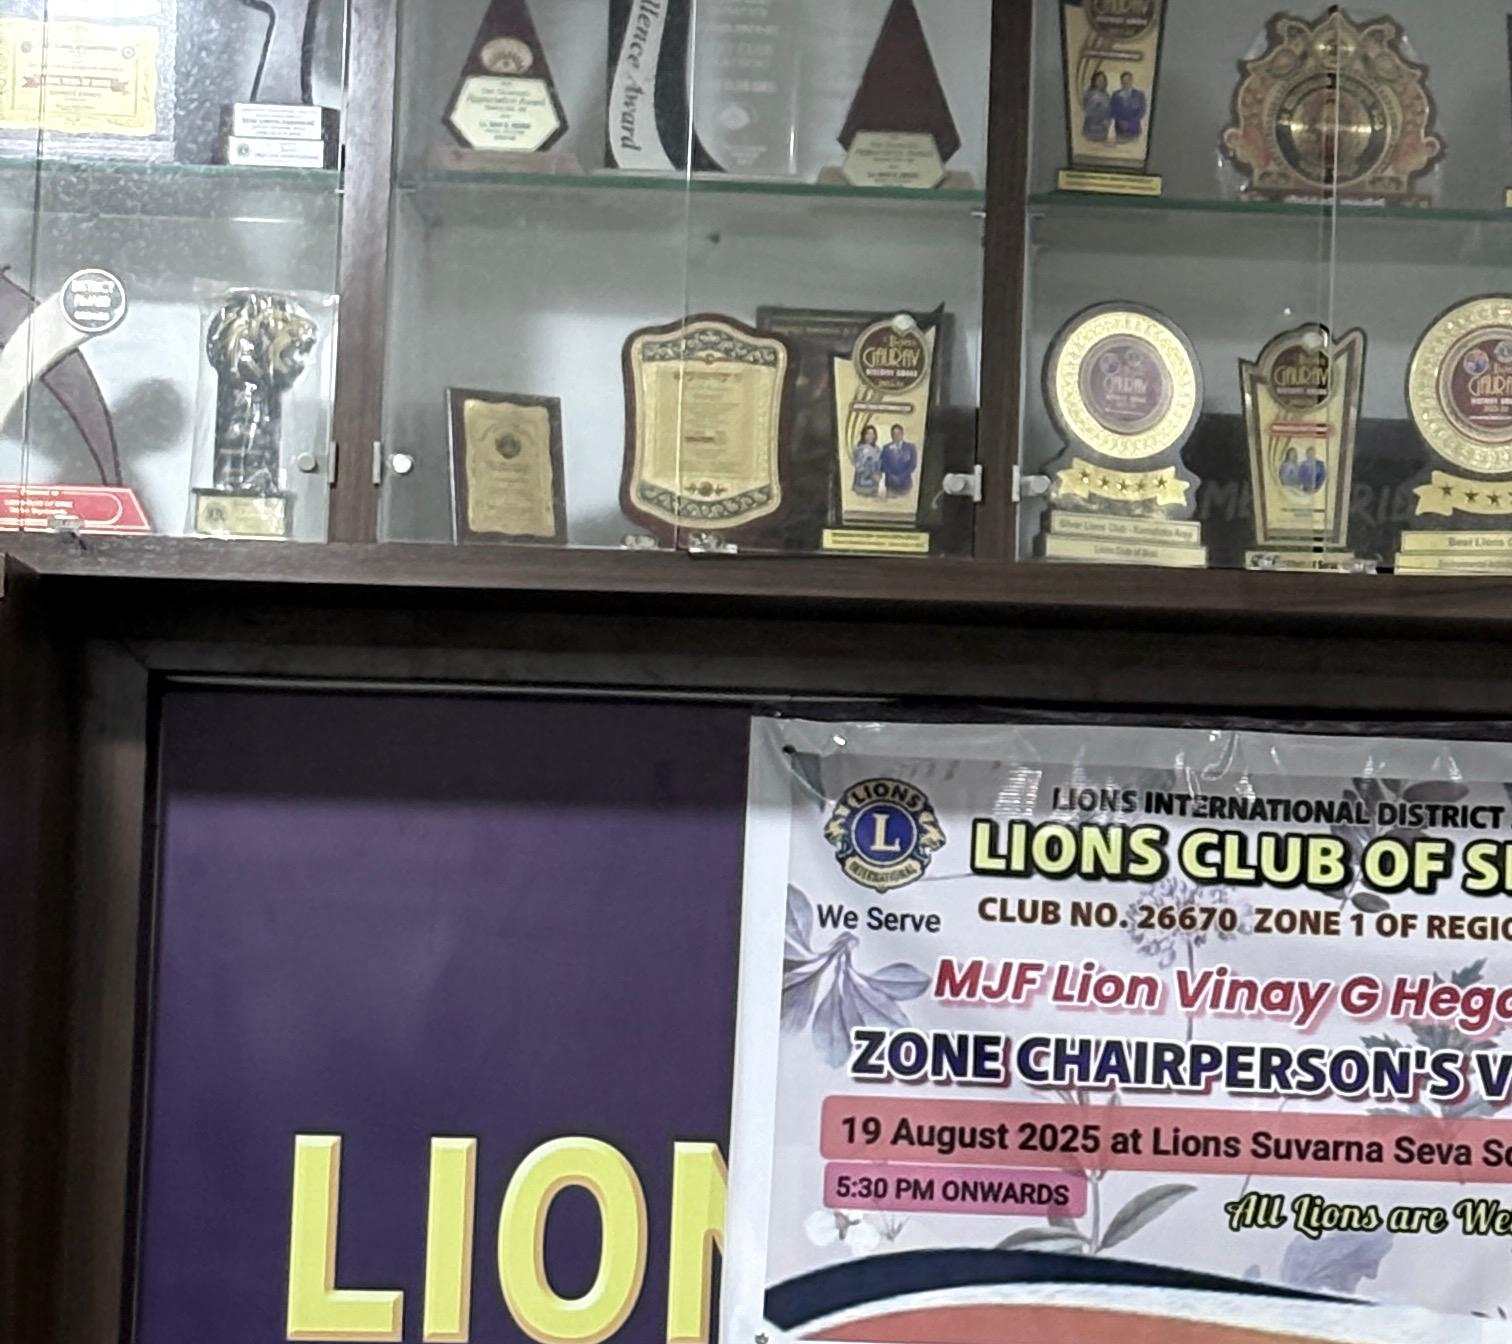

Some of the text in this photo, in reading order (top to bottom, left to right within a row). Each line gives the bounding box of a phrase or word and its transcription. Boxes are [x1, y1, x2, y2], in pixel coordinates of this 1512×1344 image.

[620, 75, 645, 152] Award
[851, 782, 921, 809] LIONS
[1053, 787, 1137, 814] LIONS
[1144, 791, 1370, 826] INTERNATIONAL
[1377, 801, 1506, 831] DISTRICT
[870, 813, 901, 851] L
[973, 819, 1167, 882] LIONS
[1180, 828, 1351, 890] CLUB
[1362, 836, 1454, 894] OF
[817, 903, 942, 934] We Serve
[978, 897, 1061, 925] CLUB
[1070, 901, 1129, 929] NO.
[1137, 904, 1238, 932] 26670
[1253, 907, 1341, 936] ZONE
[1350, 913, 1365, 937] 1
[1376, 913, 1419, 938] OF
[934, 958, 1045, 1001] MJF
[1053, 960, 1160, 1007] Lion
[1176, 965, 1332, 1026] Vinay
[1340, 975, 1383, 1013] G
[851, 1029, 1001, 1081] ZONE
[1016, 1036, 1461, 1099] CHAIRPERSON'S
[841, 1116, 882, 1145] 19
[890, 1116, 1009, 1155] August
[1018, 1122, 1101, 1153] 2025
[1111, 1128, 1143, 1155] at
[1152, 1126, 1241, 1159] Lions
[1251, 1130, 1383, 1164] Suvarna
[1393, 1135, 1472, 1167] Seva
[836, 1175, 1070, 1206] 5:30 PM ONWARDS
[1226, 1192, 1286, 1233] All
[1291, 1192, 1383, 1239] Lions
[1387, 1202, 1448, 1235] are
